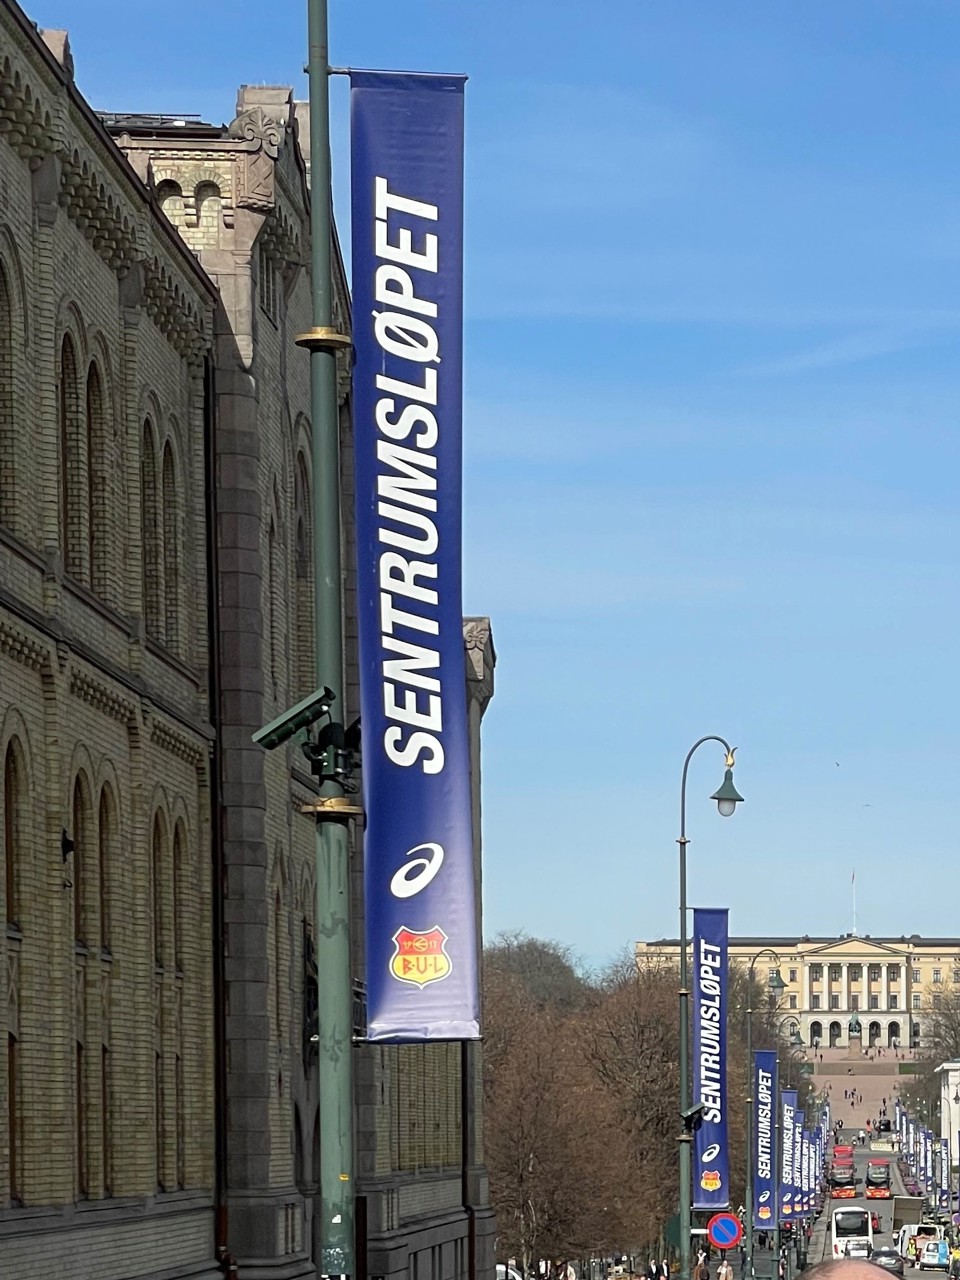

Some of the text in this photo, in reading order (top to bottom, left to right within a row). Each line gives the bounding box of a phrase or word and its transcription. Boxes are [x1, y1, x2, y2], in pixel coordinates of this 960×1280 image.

[372, 176, 445, 775] SENTRUMSLØPET
[699, 938, 722, 1124] SENTRUMSLØPET
[758, 1068, 772, 1179] SENTRUMSLØPET
[783, 1103, 794, 1185] SENTRUMSLØPET
